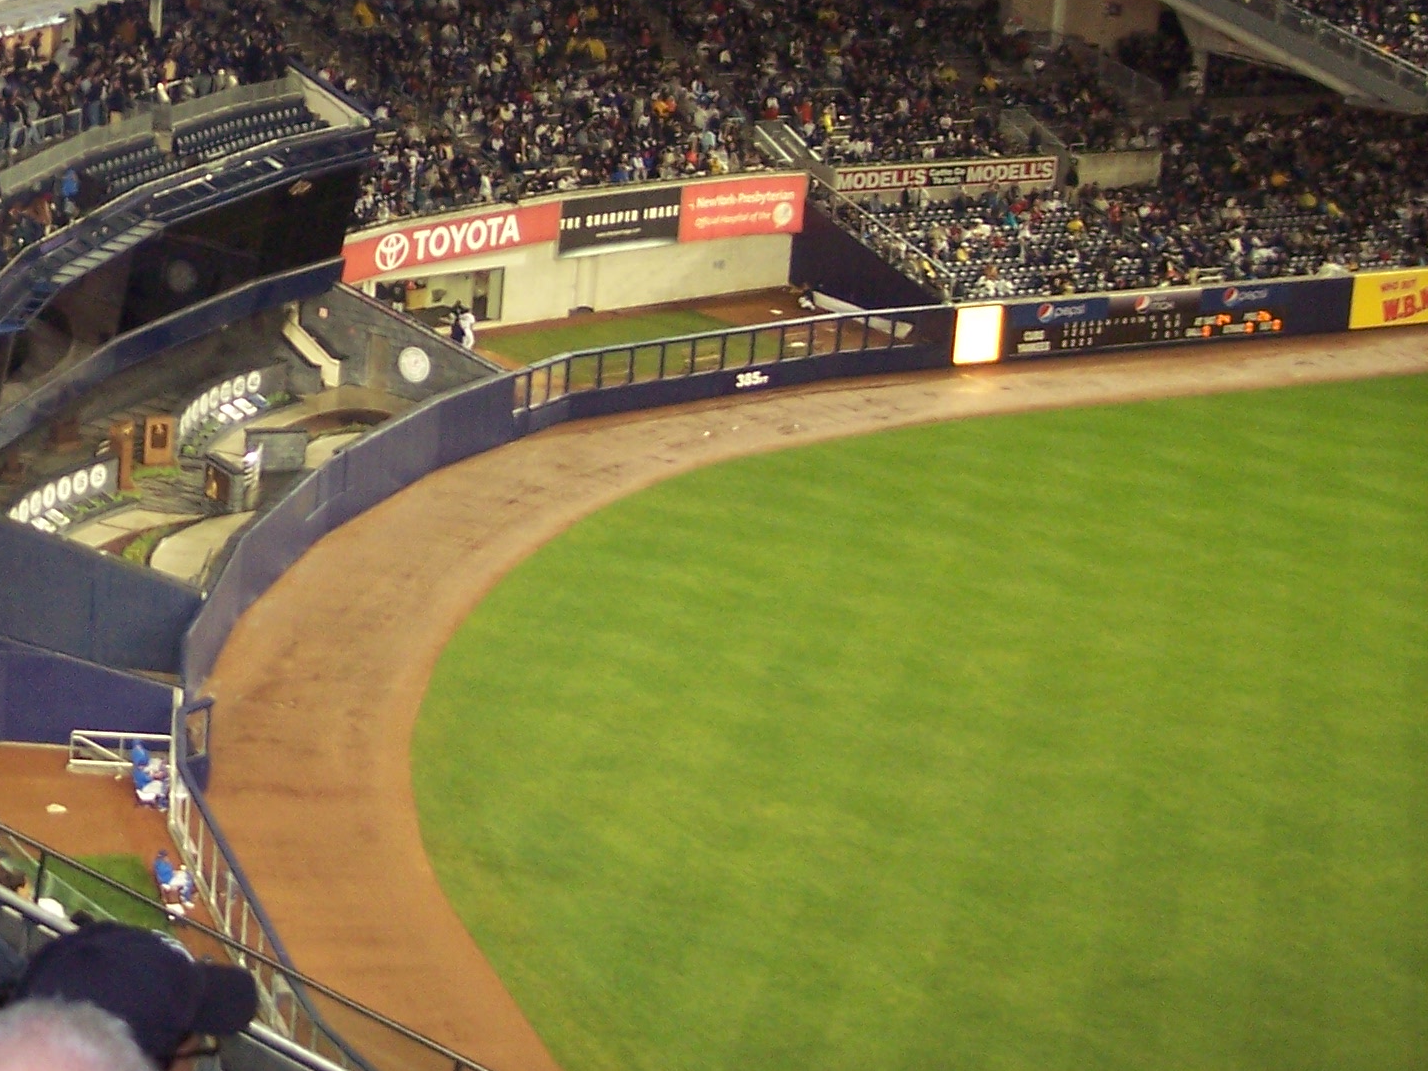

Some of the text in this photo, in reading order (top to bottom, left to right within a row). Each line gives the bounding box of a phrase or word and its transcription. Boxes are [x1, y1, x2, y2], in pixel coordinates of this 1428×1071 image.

[837, 162, 1054, 191] MODELL'S MODELL'S
[560, 204, 680, 230] THE SHARPER IMAGE
[413, 214, 520, 260] TOYOTA
